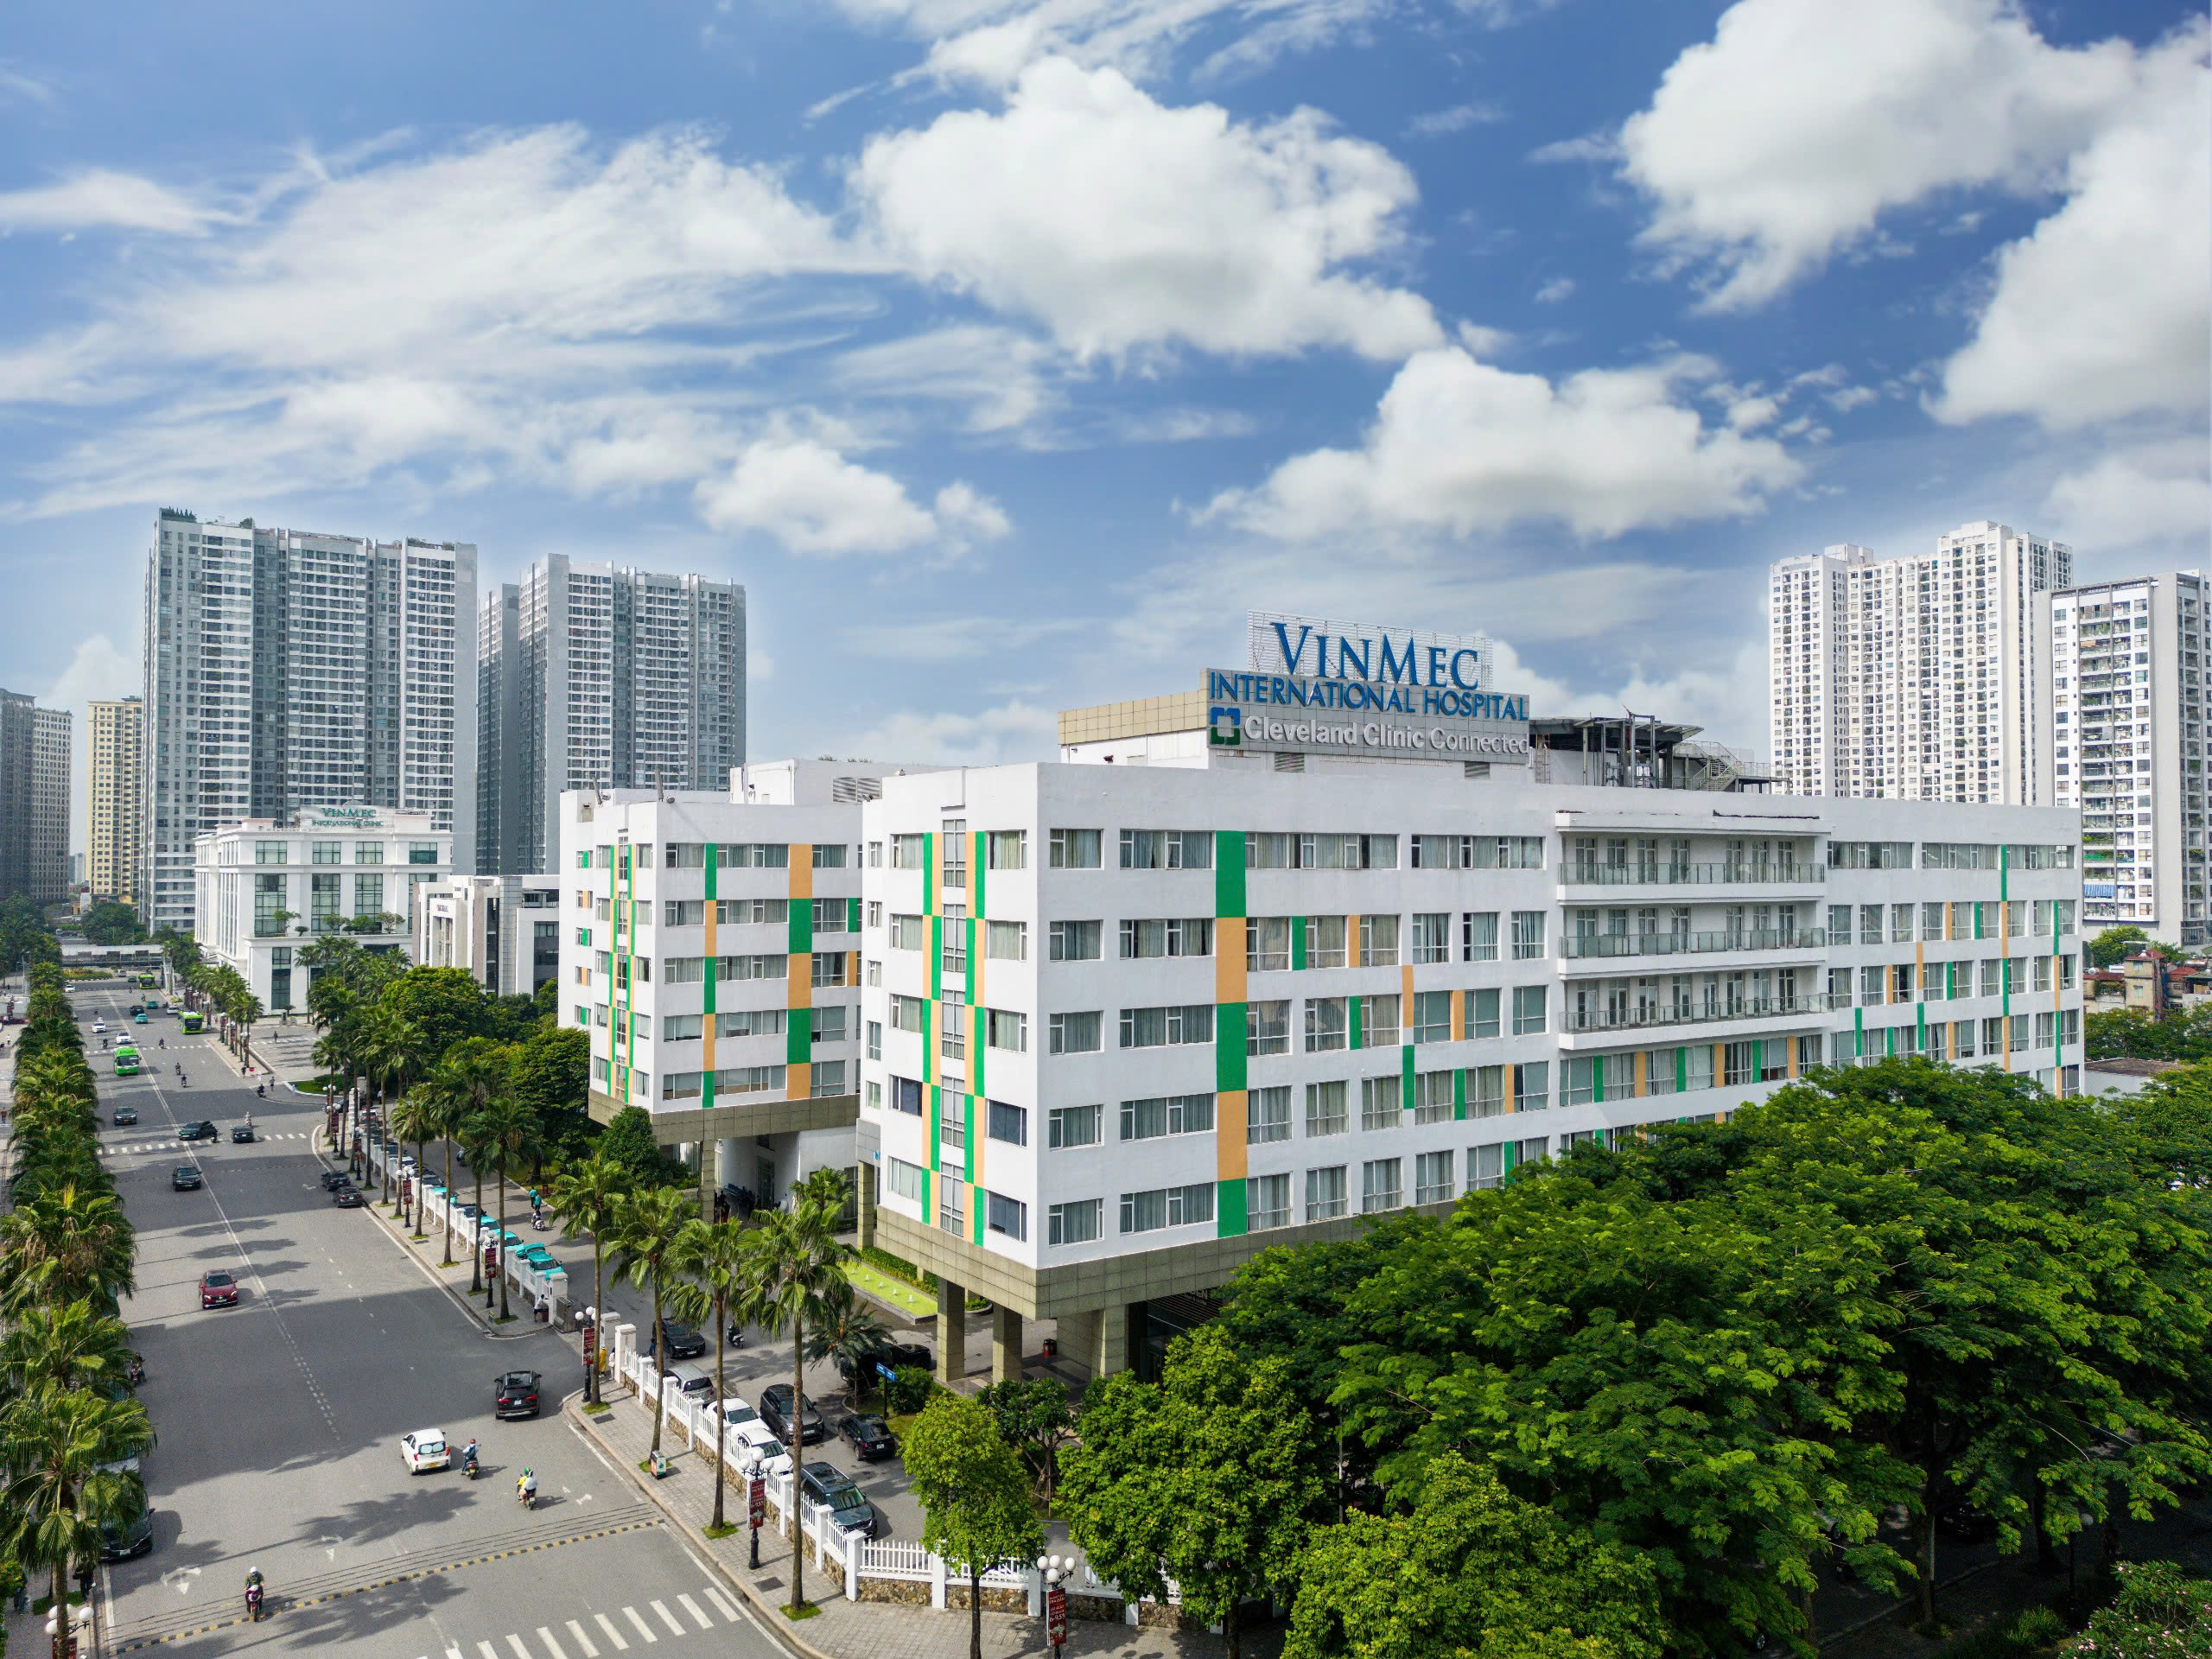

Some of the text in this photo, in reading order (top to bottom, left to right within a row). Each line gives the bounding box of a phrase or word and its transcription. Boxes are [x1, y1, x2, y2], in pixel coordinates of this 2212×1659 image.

[1269, 622, 1478, 690] VINMEC
[1210, 671, 1529, 721] INTERNATIONAL HOSPITAL
[1244, 716, 1529, 754] Cleveland Clinic Connected
[321, 808, 377, 817] VINMEC
